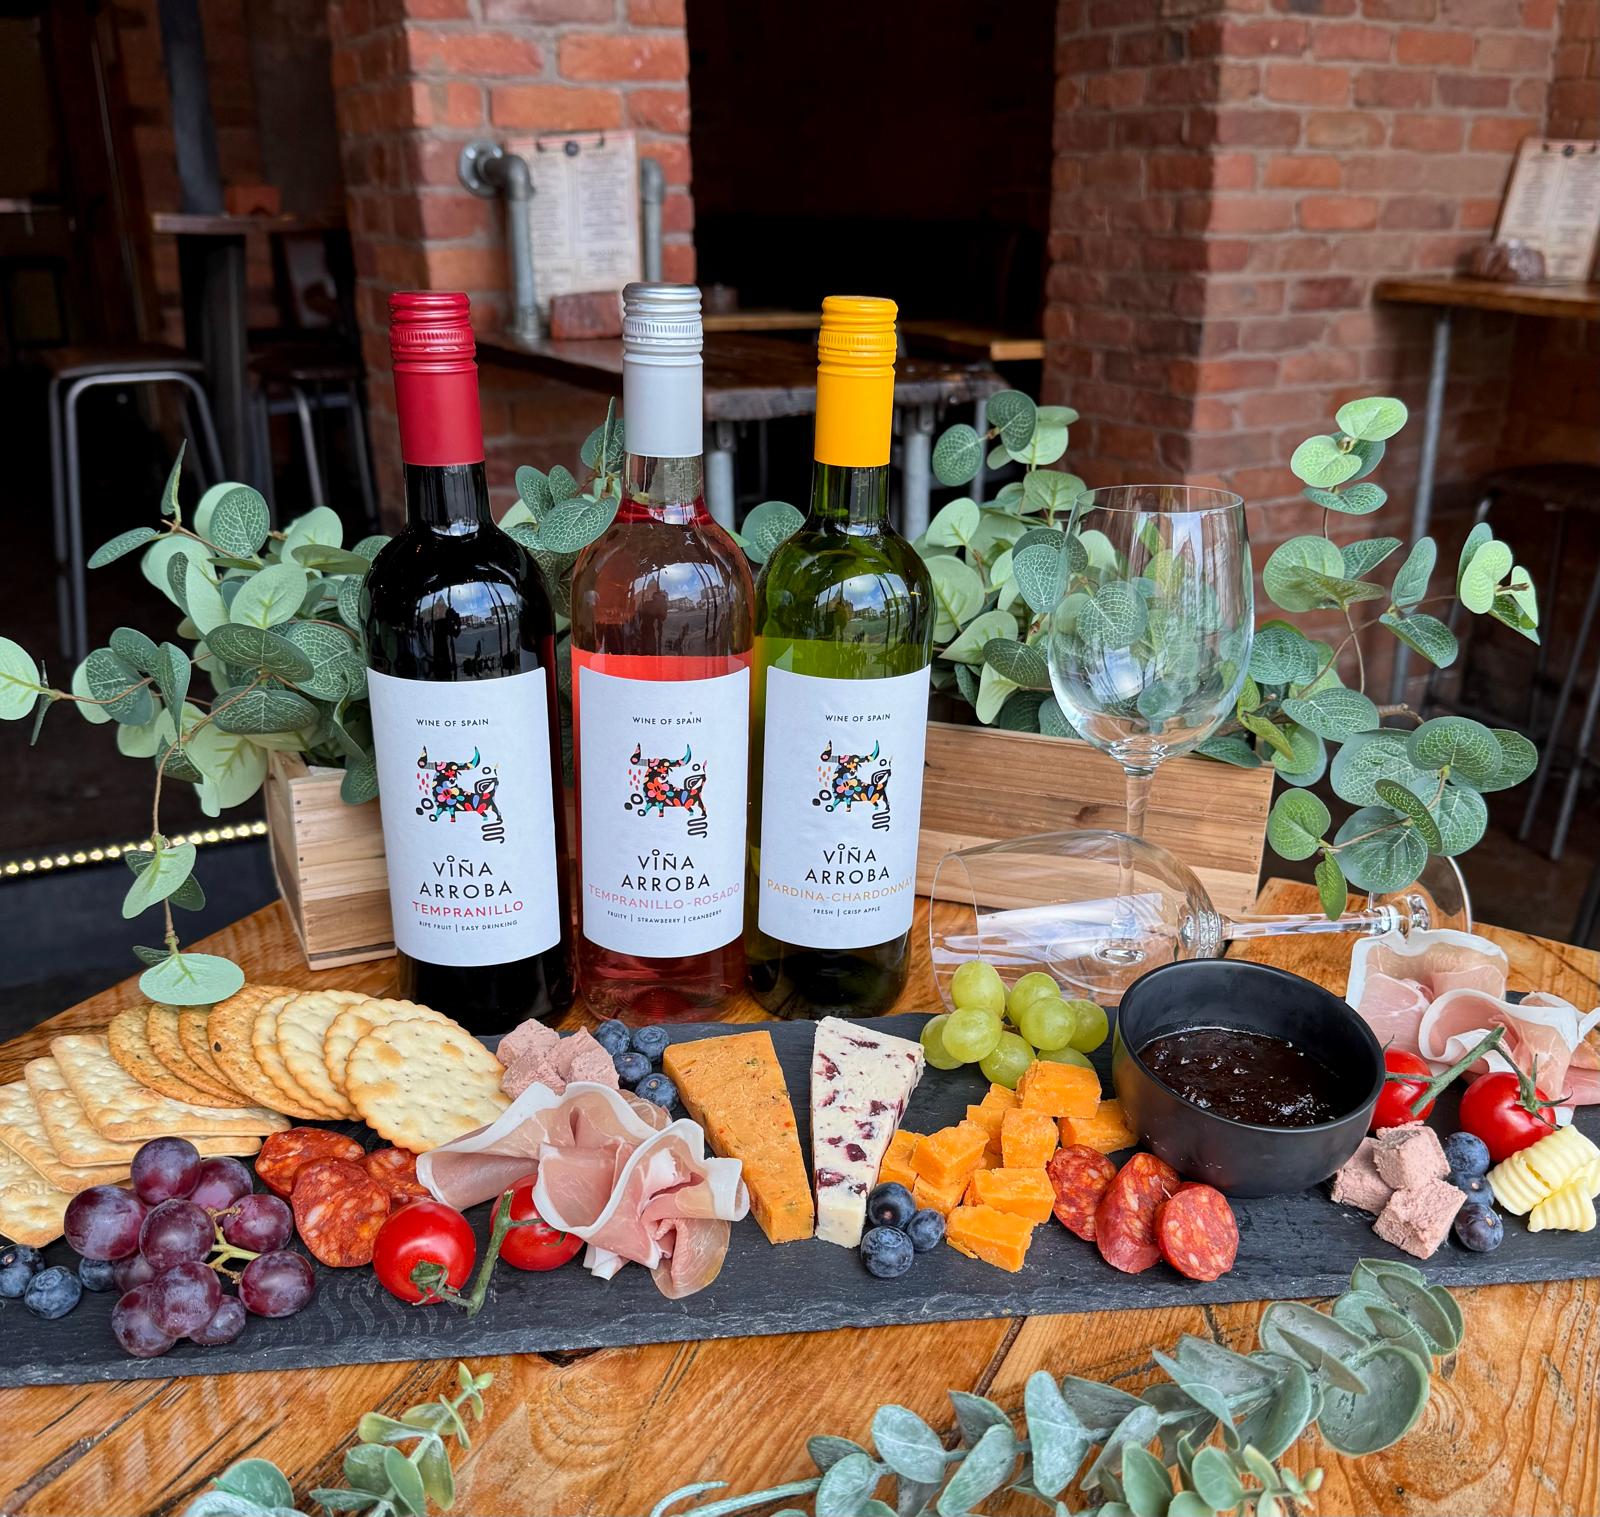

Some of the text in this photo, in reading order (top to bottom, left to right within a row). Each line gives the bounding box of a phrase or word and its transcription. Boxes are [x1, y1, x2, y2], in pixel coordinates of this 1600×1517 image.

[416, 719, 440, 727] WINE
[461, 718, 489, 726] SPAIN
[633, 716, 656, 725] WINE
[676, 717, 702, 725] SPAIN
[825, 714, 848, 722] WINE
[867, 713, 891, 722] SPAIN
[637, 848, 694, 871] VIÑA
[823, 843, 876, 865] VIÑA
[433, 855, 493, 878] VIÑA
[805, 866, 889, 885] ARROBA
[419, 880, 512, 899] ARROBA
[621, 874, 710, 892] ARROBA
[412, 900, 524, 918] TEMPRANILLO
[607, 911, 627, 920] FRUITY
[688, 909, 722, 922] CRANBERRY
[864, 906, 880, 914] APPLE
[434, 923, 452, 931] FRUIT
[461, 923, 479, 931] EASY
[482, 920, 518, 930] DRINKING
